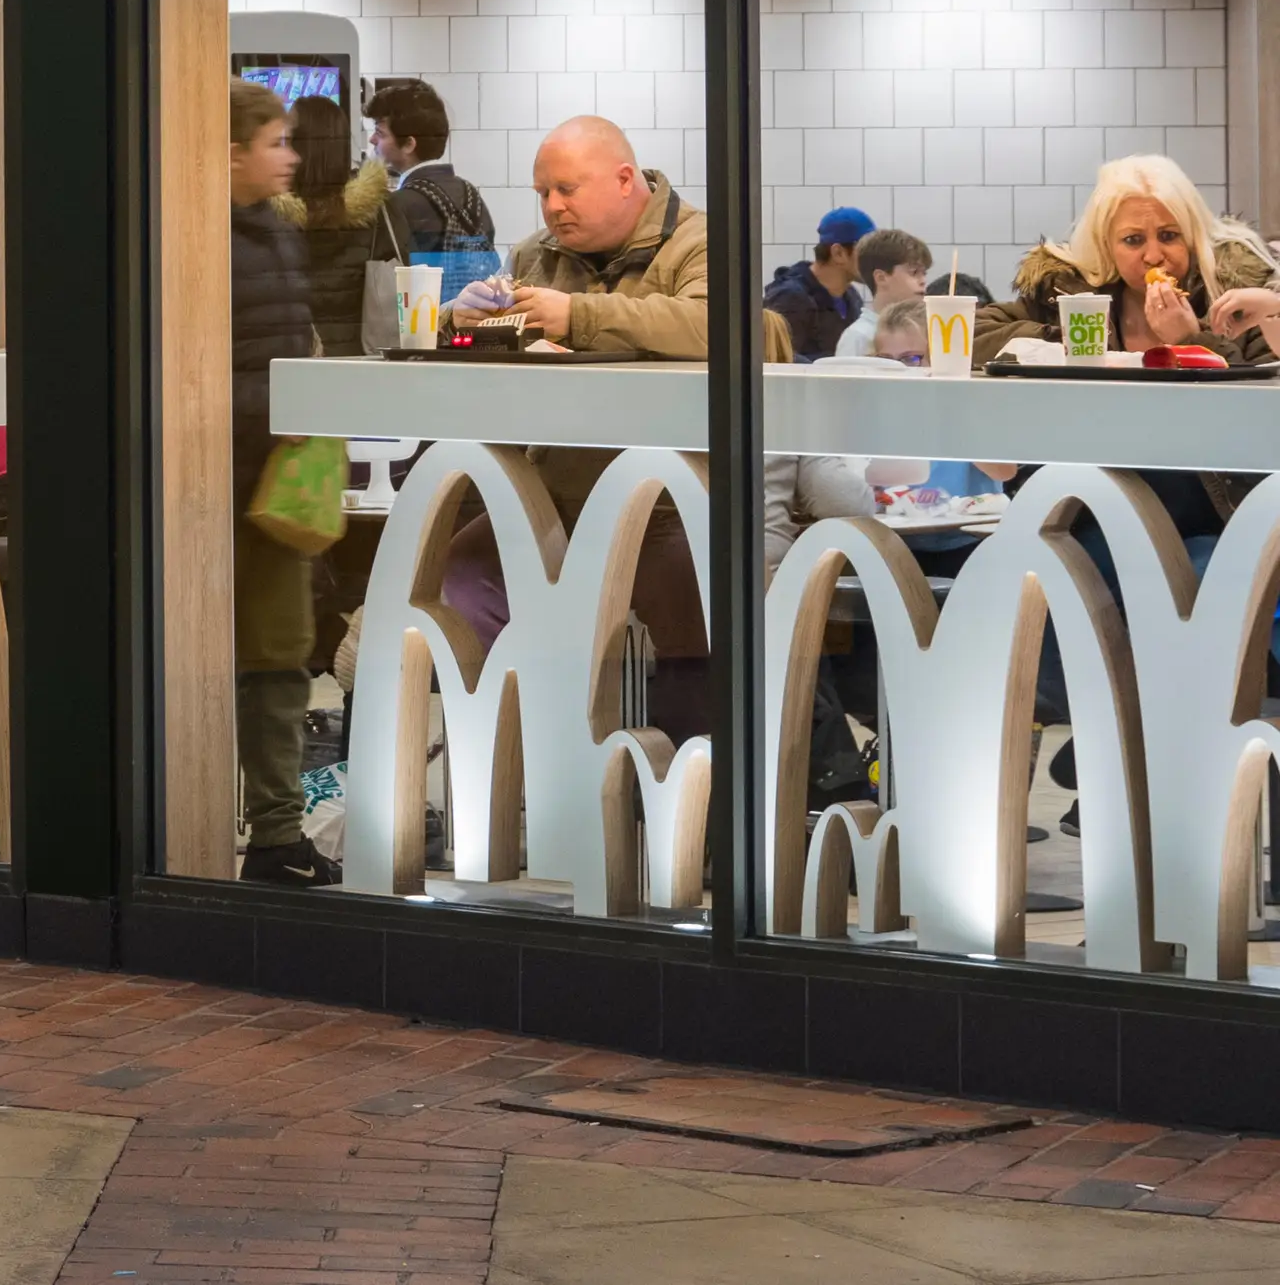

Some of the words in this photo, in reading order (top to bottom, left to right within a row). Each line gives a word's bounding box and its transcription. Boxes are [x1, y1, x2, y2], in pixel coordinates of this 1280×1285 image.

[1069, 312, 1106, 326] McD
[1069, 325, 1105, 344] on
[1071, 344, 1104, 356] ald's
